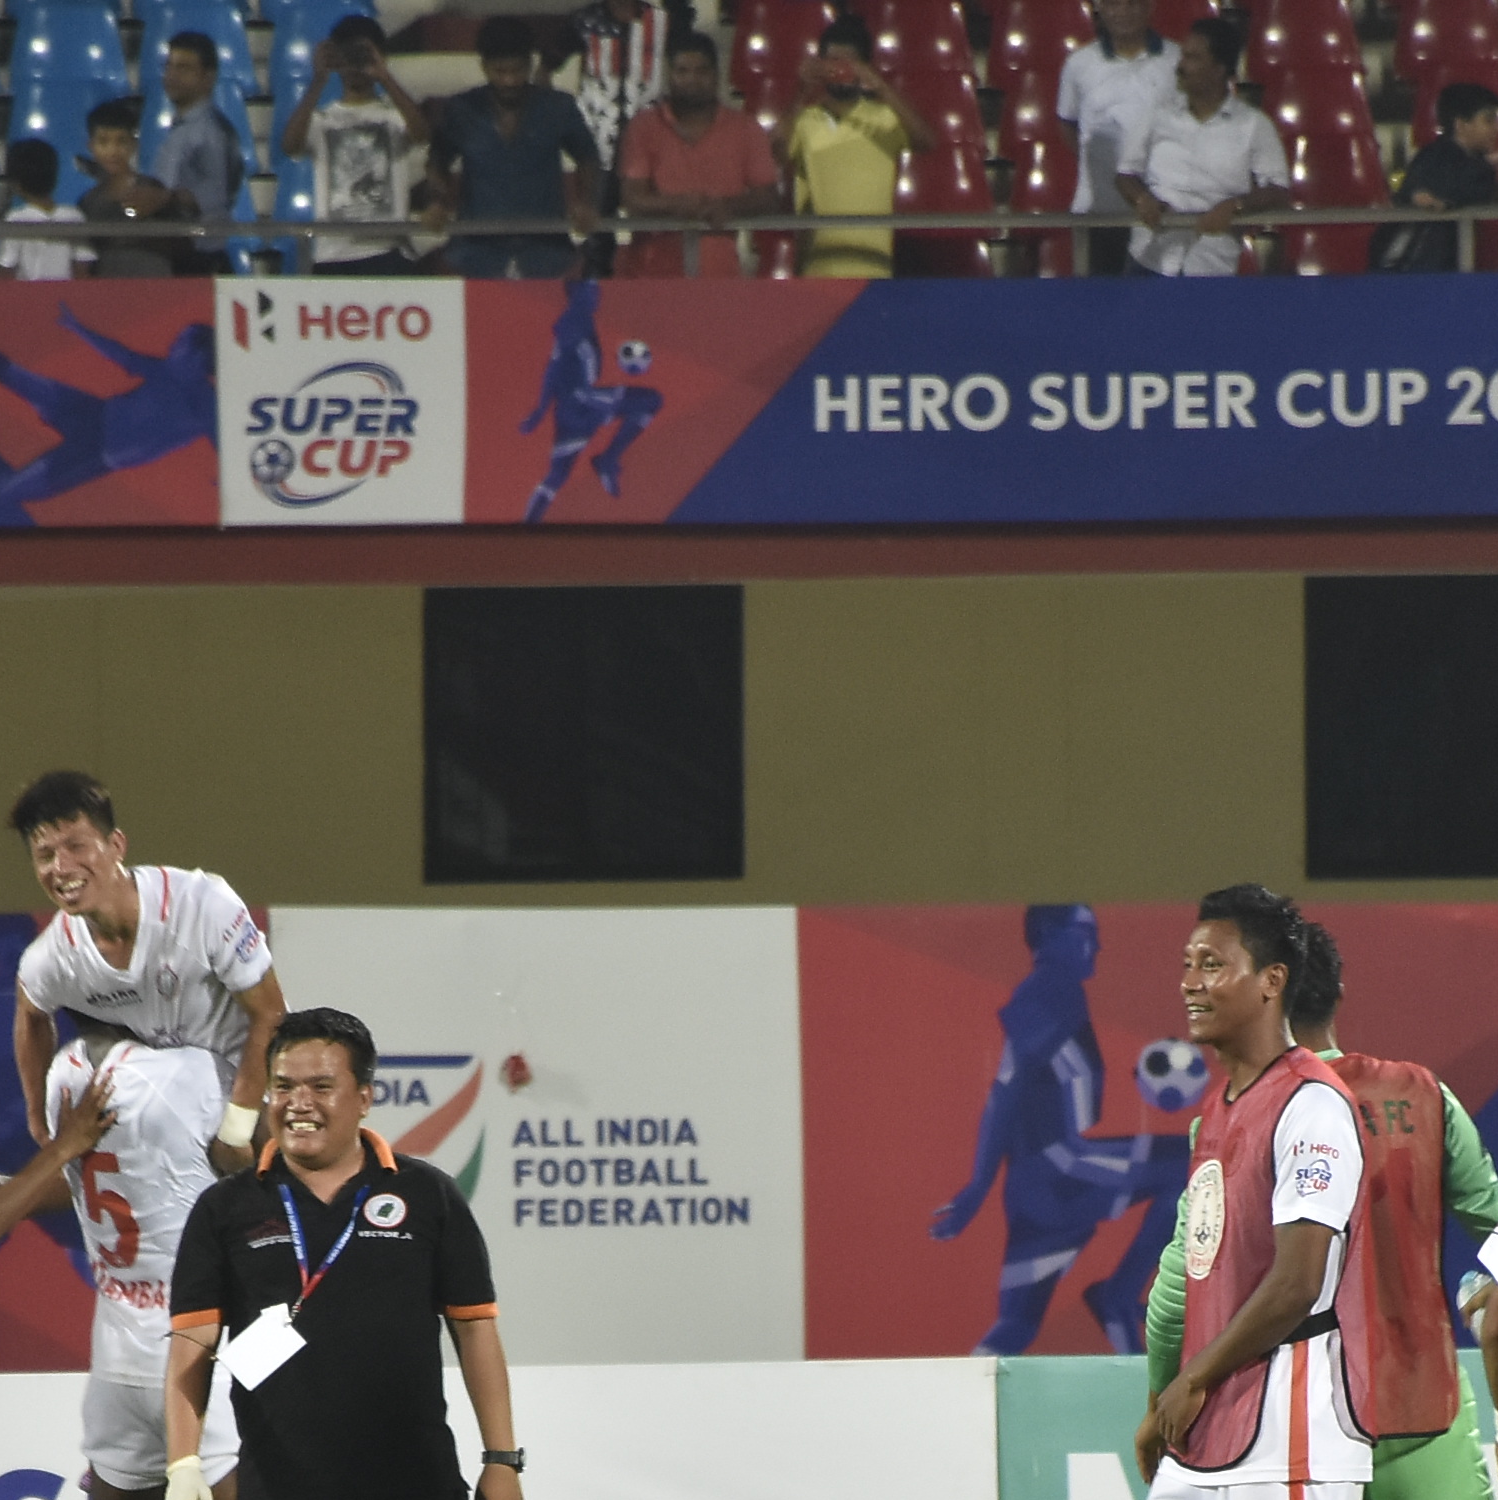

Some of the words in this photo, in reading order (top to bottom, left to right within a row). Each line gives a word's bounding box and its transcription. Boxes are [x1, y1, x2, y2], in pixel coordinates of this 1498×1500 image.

[246, 398, 419, 436] SUPER
[813, 375, 1011, 433] HERO
[1029, 372, 1258, 431] SUPER
[1276, 369, 1429, 428] CUP
[302, 439, 412, 478] CUP
[372, 1079, 431, 1107] DIA
[512, 1118, 584, 1148] ALL
[596, 1117, 699, 1147] INDIA
[513, 1158, 709, 1187] FOOTBALL
[81, 1151, 140, 1269] 5
[513, 1197, 751, 1227] FEDERATION
